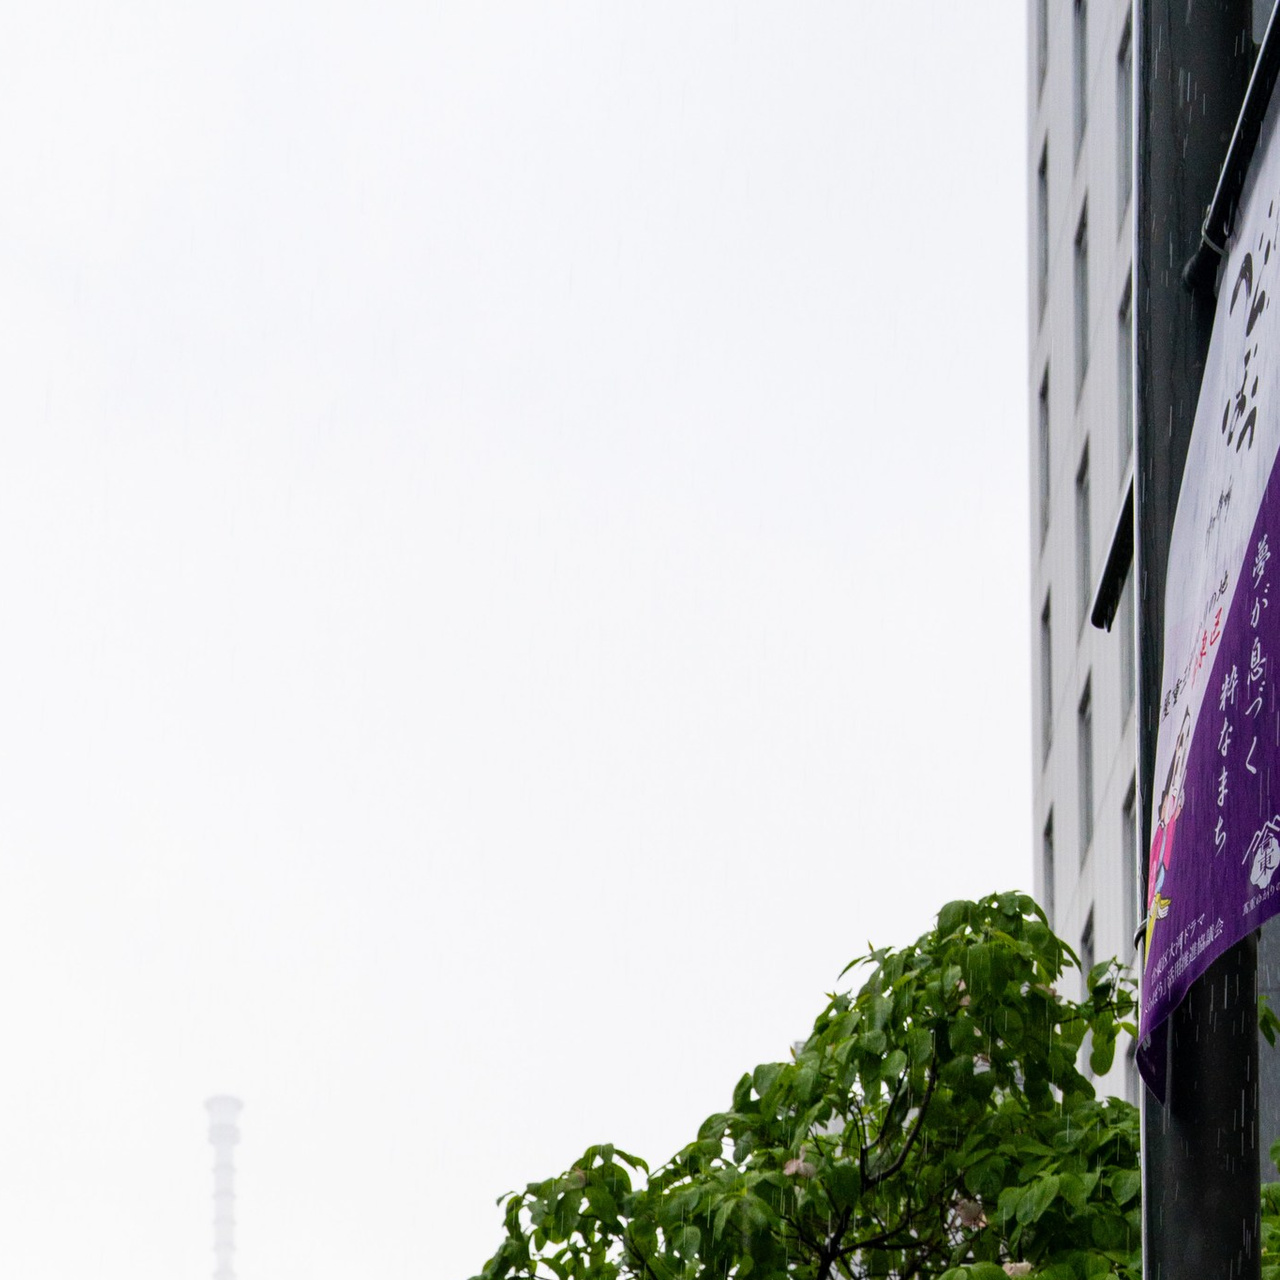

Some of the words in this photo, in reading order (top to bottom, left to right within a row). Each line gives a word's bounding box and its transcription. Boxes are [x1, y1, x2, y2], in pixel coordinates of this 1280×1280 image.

[1215, 664, 1239, 857] 粋なまち
[1245, 534, 1271, 774] 夢が息づく
